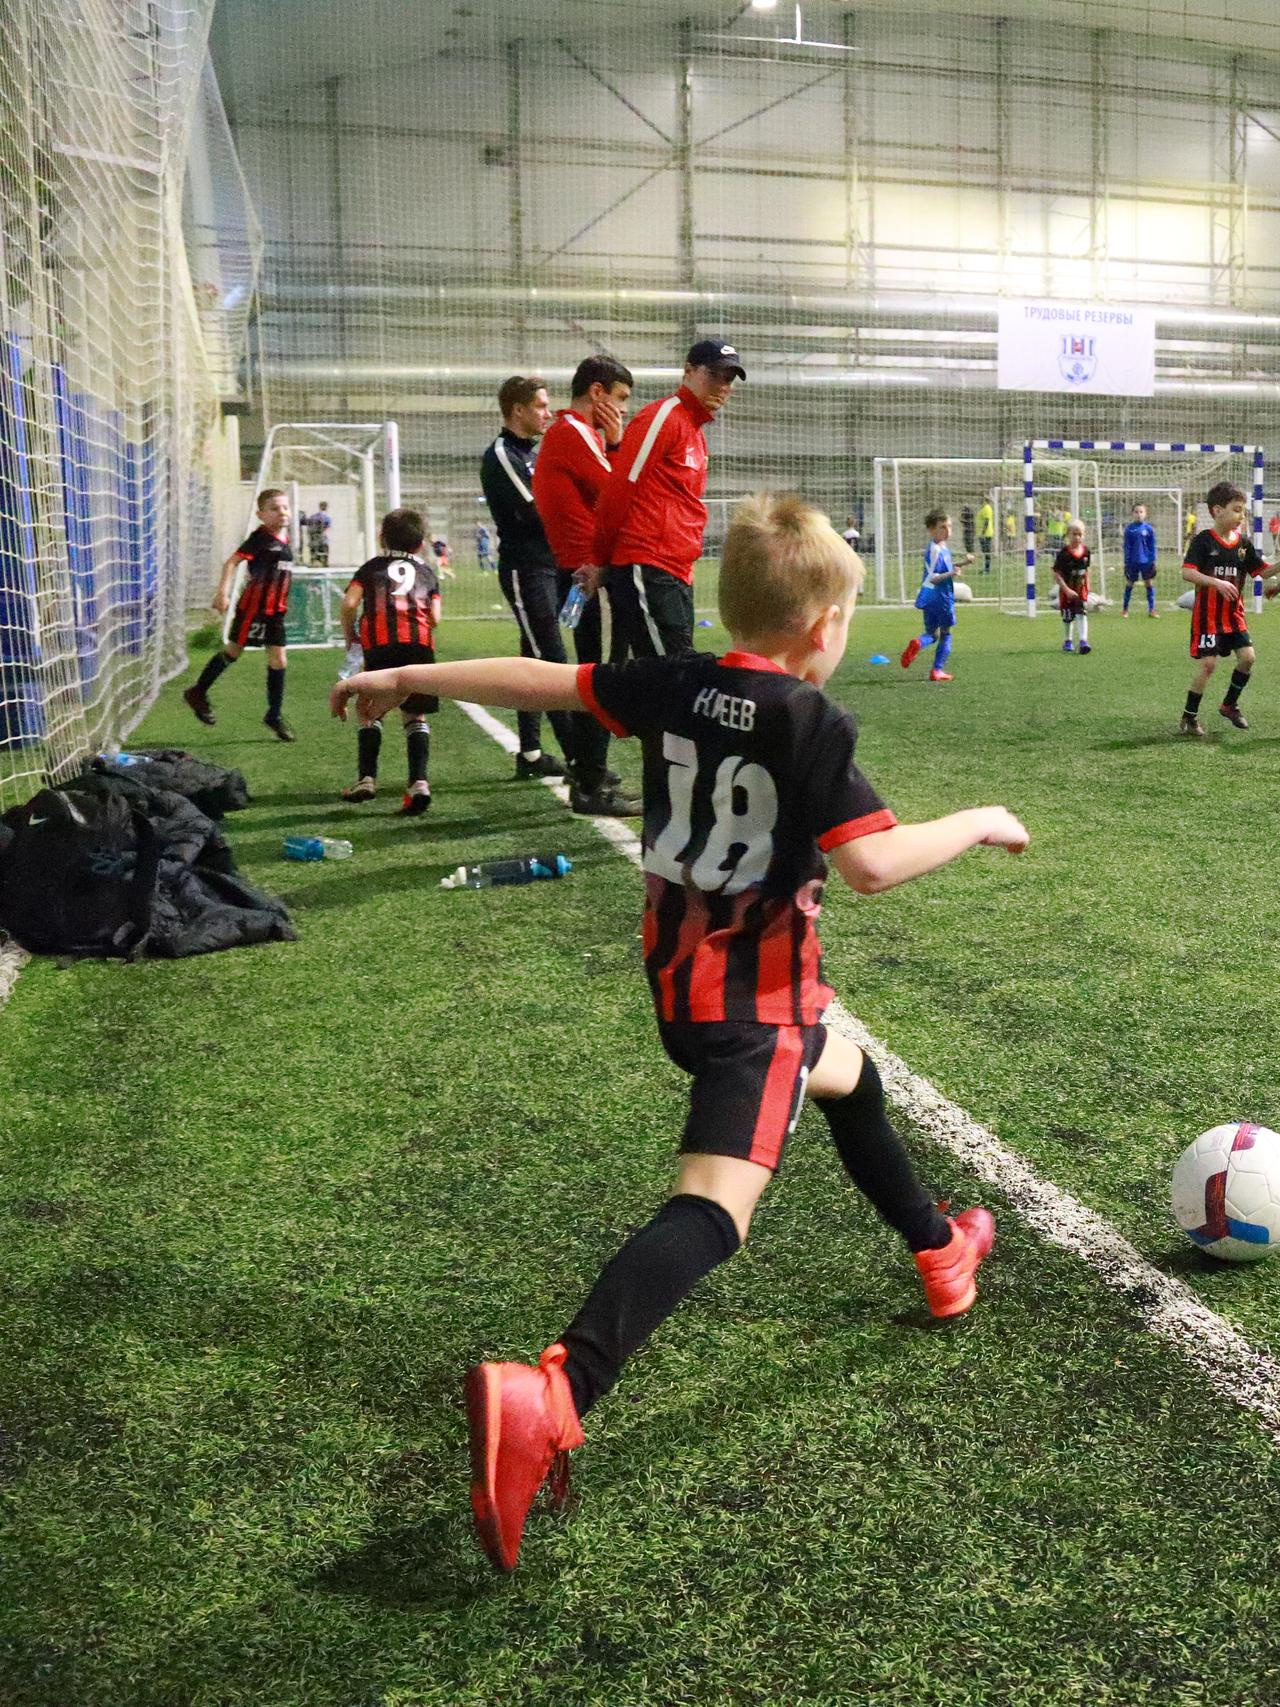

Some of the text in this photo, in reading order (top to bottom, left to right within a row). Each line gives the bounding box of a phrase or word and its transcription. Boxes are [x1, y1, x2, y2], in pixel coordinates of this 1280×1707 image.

[1024, 306, 1133, 325] ТРУДОВЫЕ РЕЗЕРВЫ
[387, 559, 416, 595] 9
[248, 623, 266, 639] 21
[1199, 634, 1216, 648] 13
[643, 731, 778, 895] 18
